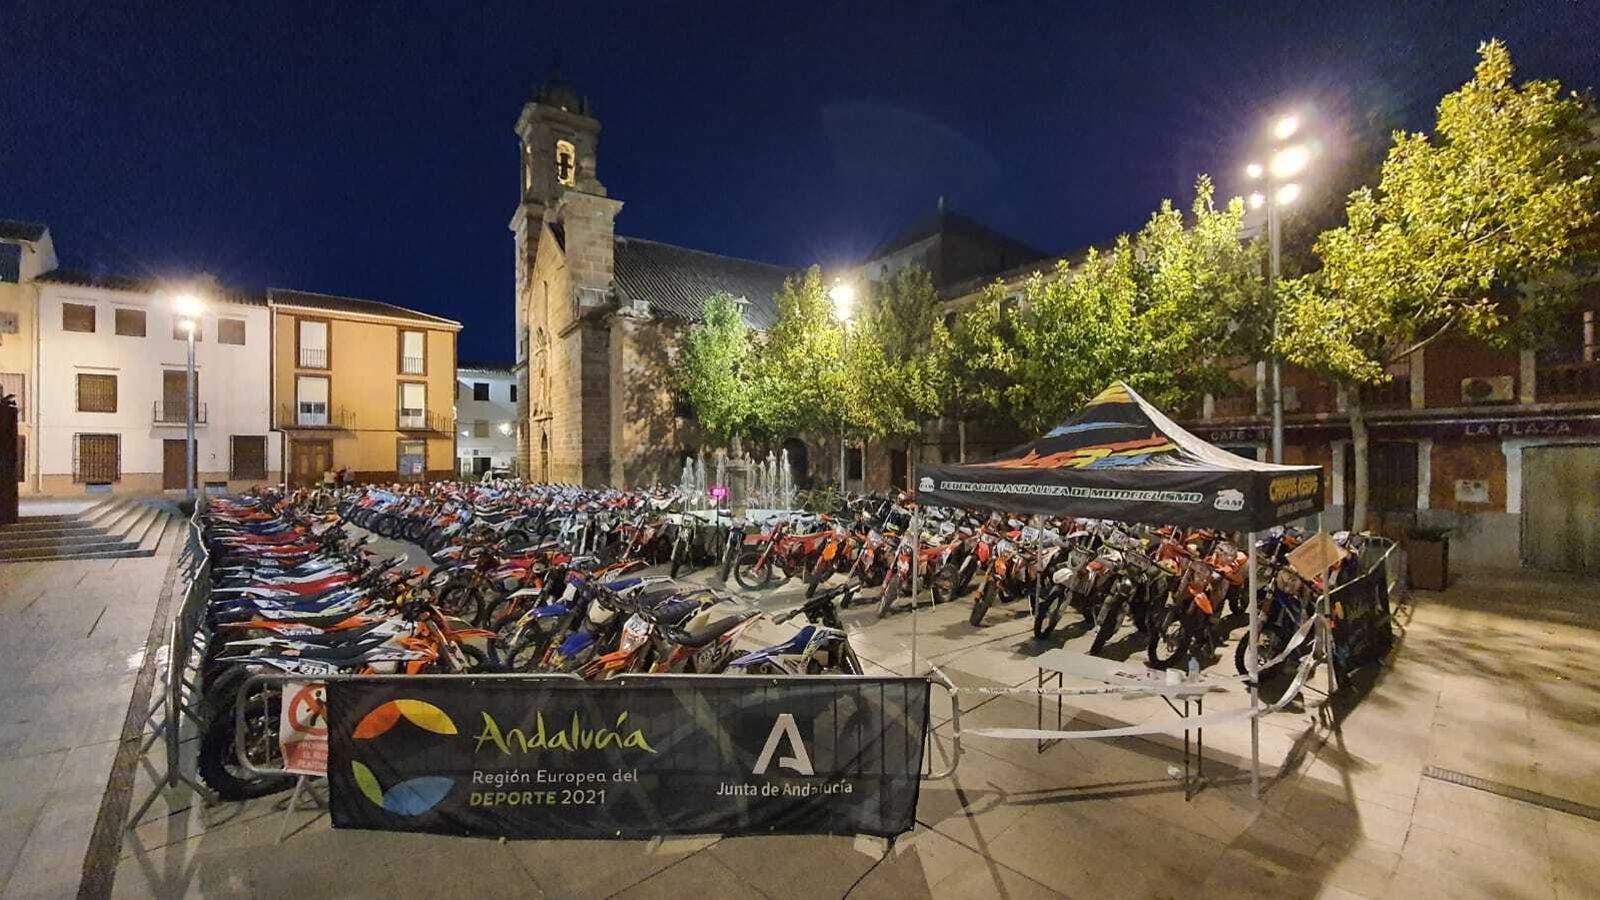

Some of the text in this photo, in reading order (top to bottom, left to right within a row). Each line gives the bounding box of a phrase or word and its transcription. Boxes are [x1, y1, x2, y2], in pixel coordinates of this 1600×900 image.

[1465, 422, 1570, 436] LA PLAZA
[1003, 483, 1069, 496] ANDALUZA
[1071, 487, 1090, 499] DE
[1091, 488, 1204, 503] MOTOCICLISMO
[1215, 498, 1243, 508] FAM
[473, 710, 658, 755] Andalucía
[472, 768, 638, 787] Región Europea del
[716, 779, 853, 797] Junta de Andalucía
[470, 789, 606, 806] DEPORTE 2021
